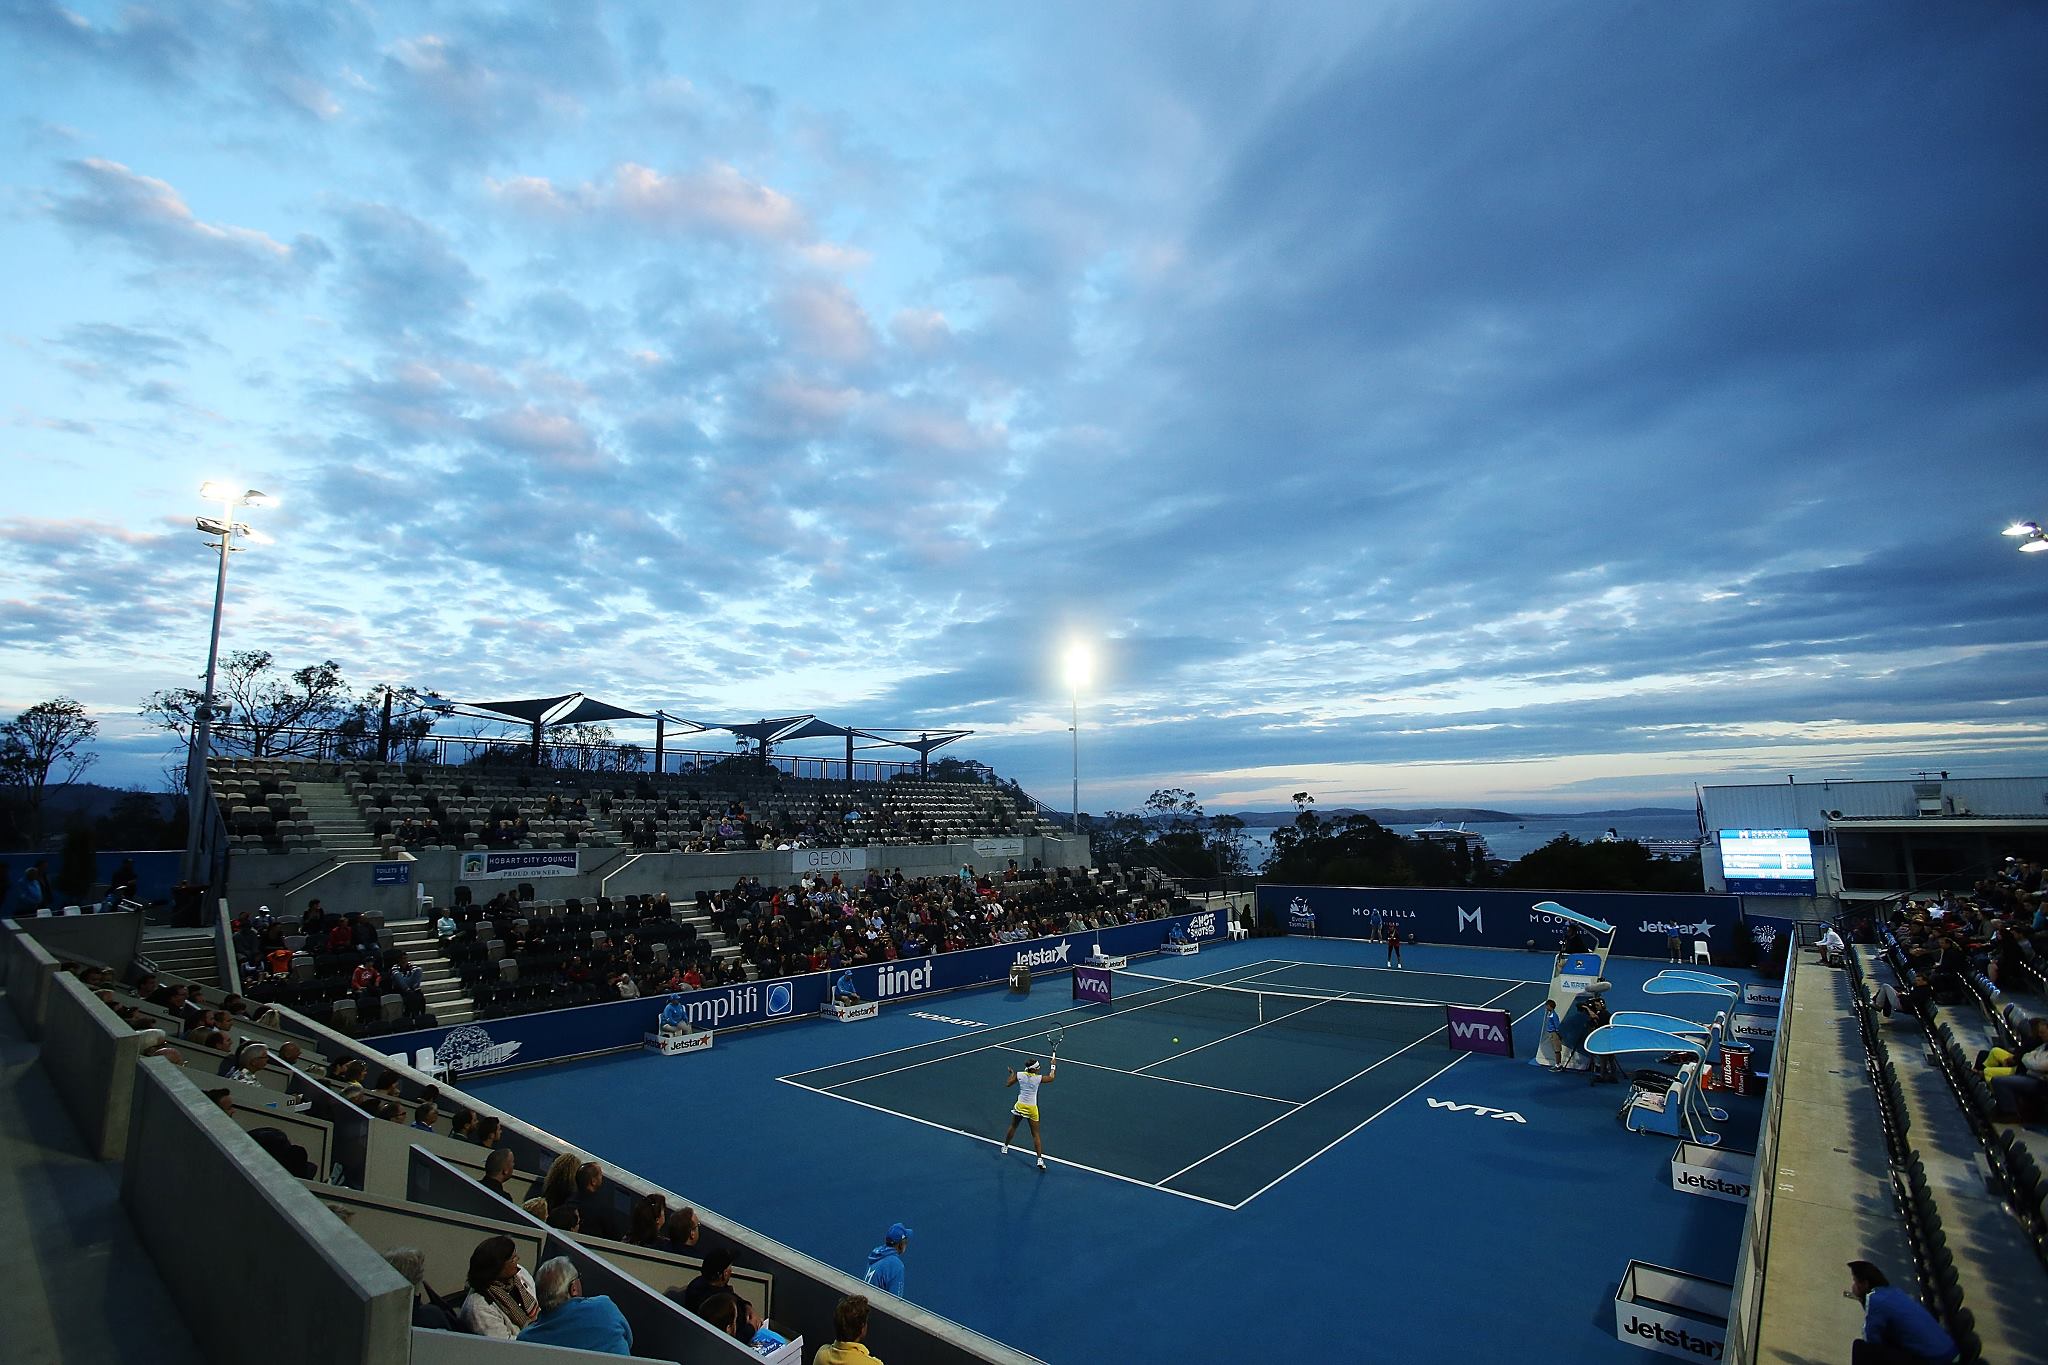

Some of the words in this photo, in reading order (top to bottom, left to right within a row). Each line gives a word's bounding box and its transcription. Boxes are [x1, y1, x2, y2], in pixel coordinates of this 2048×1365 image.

[488, 857, 522, 865] HOBART
[523, 855, 541, 864] CITY
[542, 854, 575, 863] COUNCIL
[808, 850, 852, 866] GEON
[503, 869, 530, 877] PROUD
[530, 868, 561, 877] OWNERS
[1352, 907, 1416, 918] MORILLA
[1456, 905, 1484, 933] M
[1012, 947, 1057, 967] Jetstar
[877, 959, 932, 997] iinet
[1076, 976, 1108, 994] WTA
[1451, 1020, 1505, 1042] WTA
[671, 1038, 701, 1050] Jetstar
[1723, 1053, 1734, 1088] Wilson
[1426, 1097, 1527, 1123] WTA
[1677, 1171, 1744, 1197] Jetstar
[1623, 1316, 1717, 1357] Jetstar
